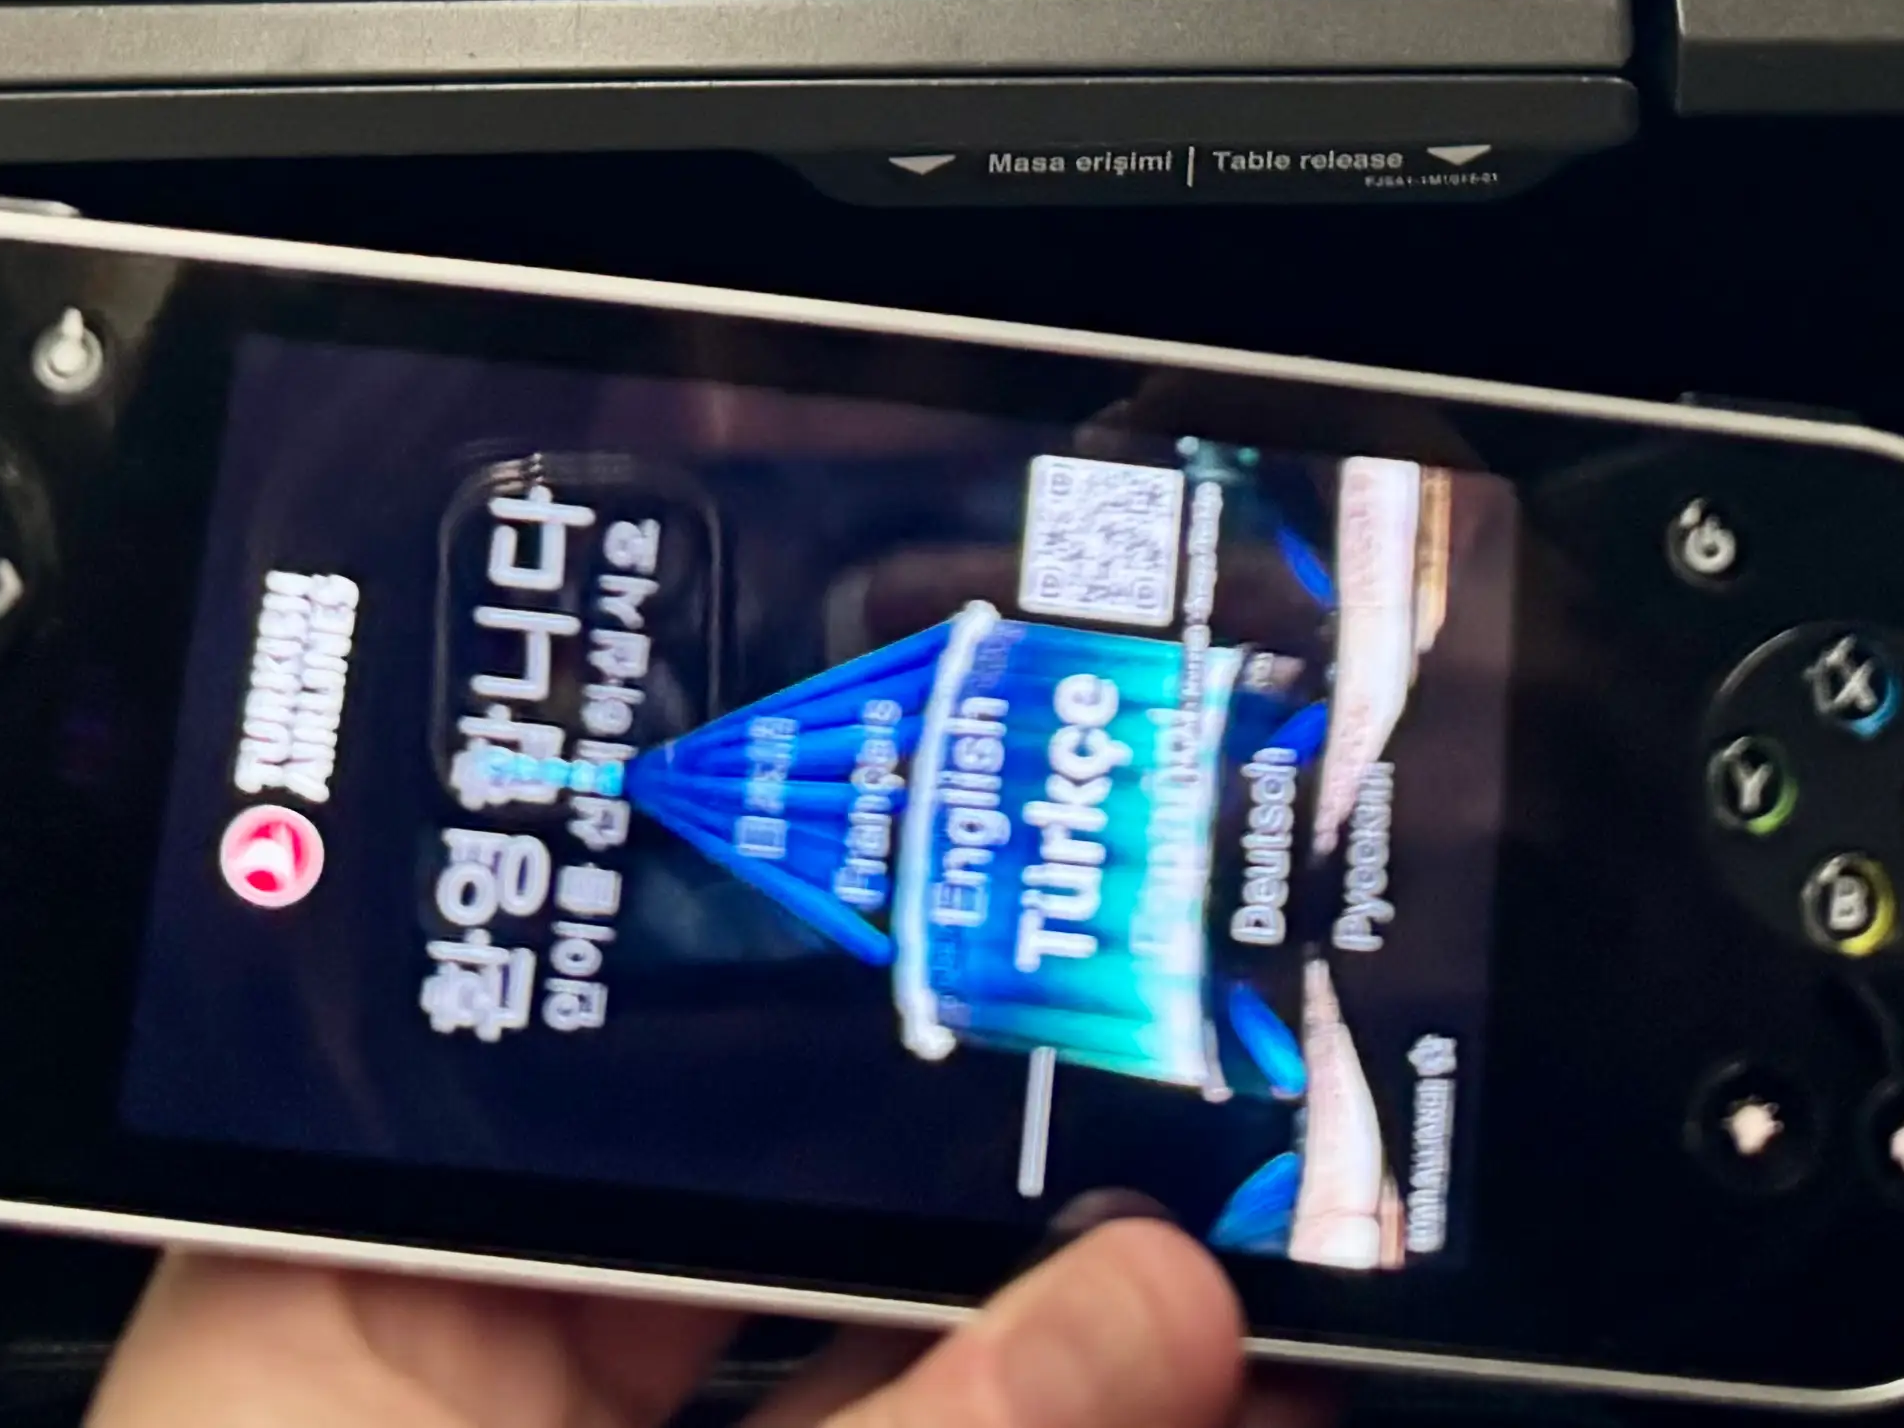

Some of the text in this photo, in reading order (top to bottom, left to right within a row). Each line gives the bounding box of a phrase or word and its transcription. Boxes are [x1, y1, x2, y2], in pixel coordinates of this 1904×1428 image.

[988, 150, 1173, 176] Masa erişimi
[1213, 150, 1403, 171] Table release
[234, 568, 311, 792] TURKISH
[284, 572, 359, 802] AIRLINES
[930, 693, 1013, 929] English
[1014, 672, 1136, 971] Türkçe
[1229, 745, 1298, 944] Deutsch
[1733, 759, 1773, 812] Y
[1828, 876, 1870, 932] B
